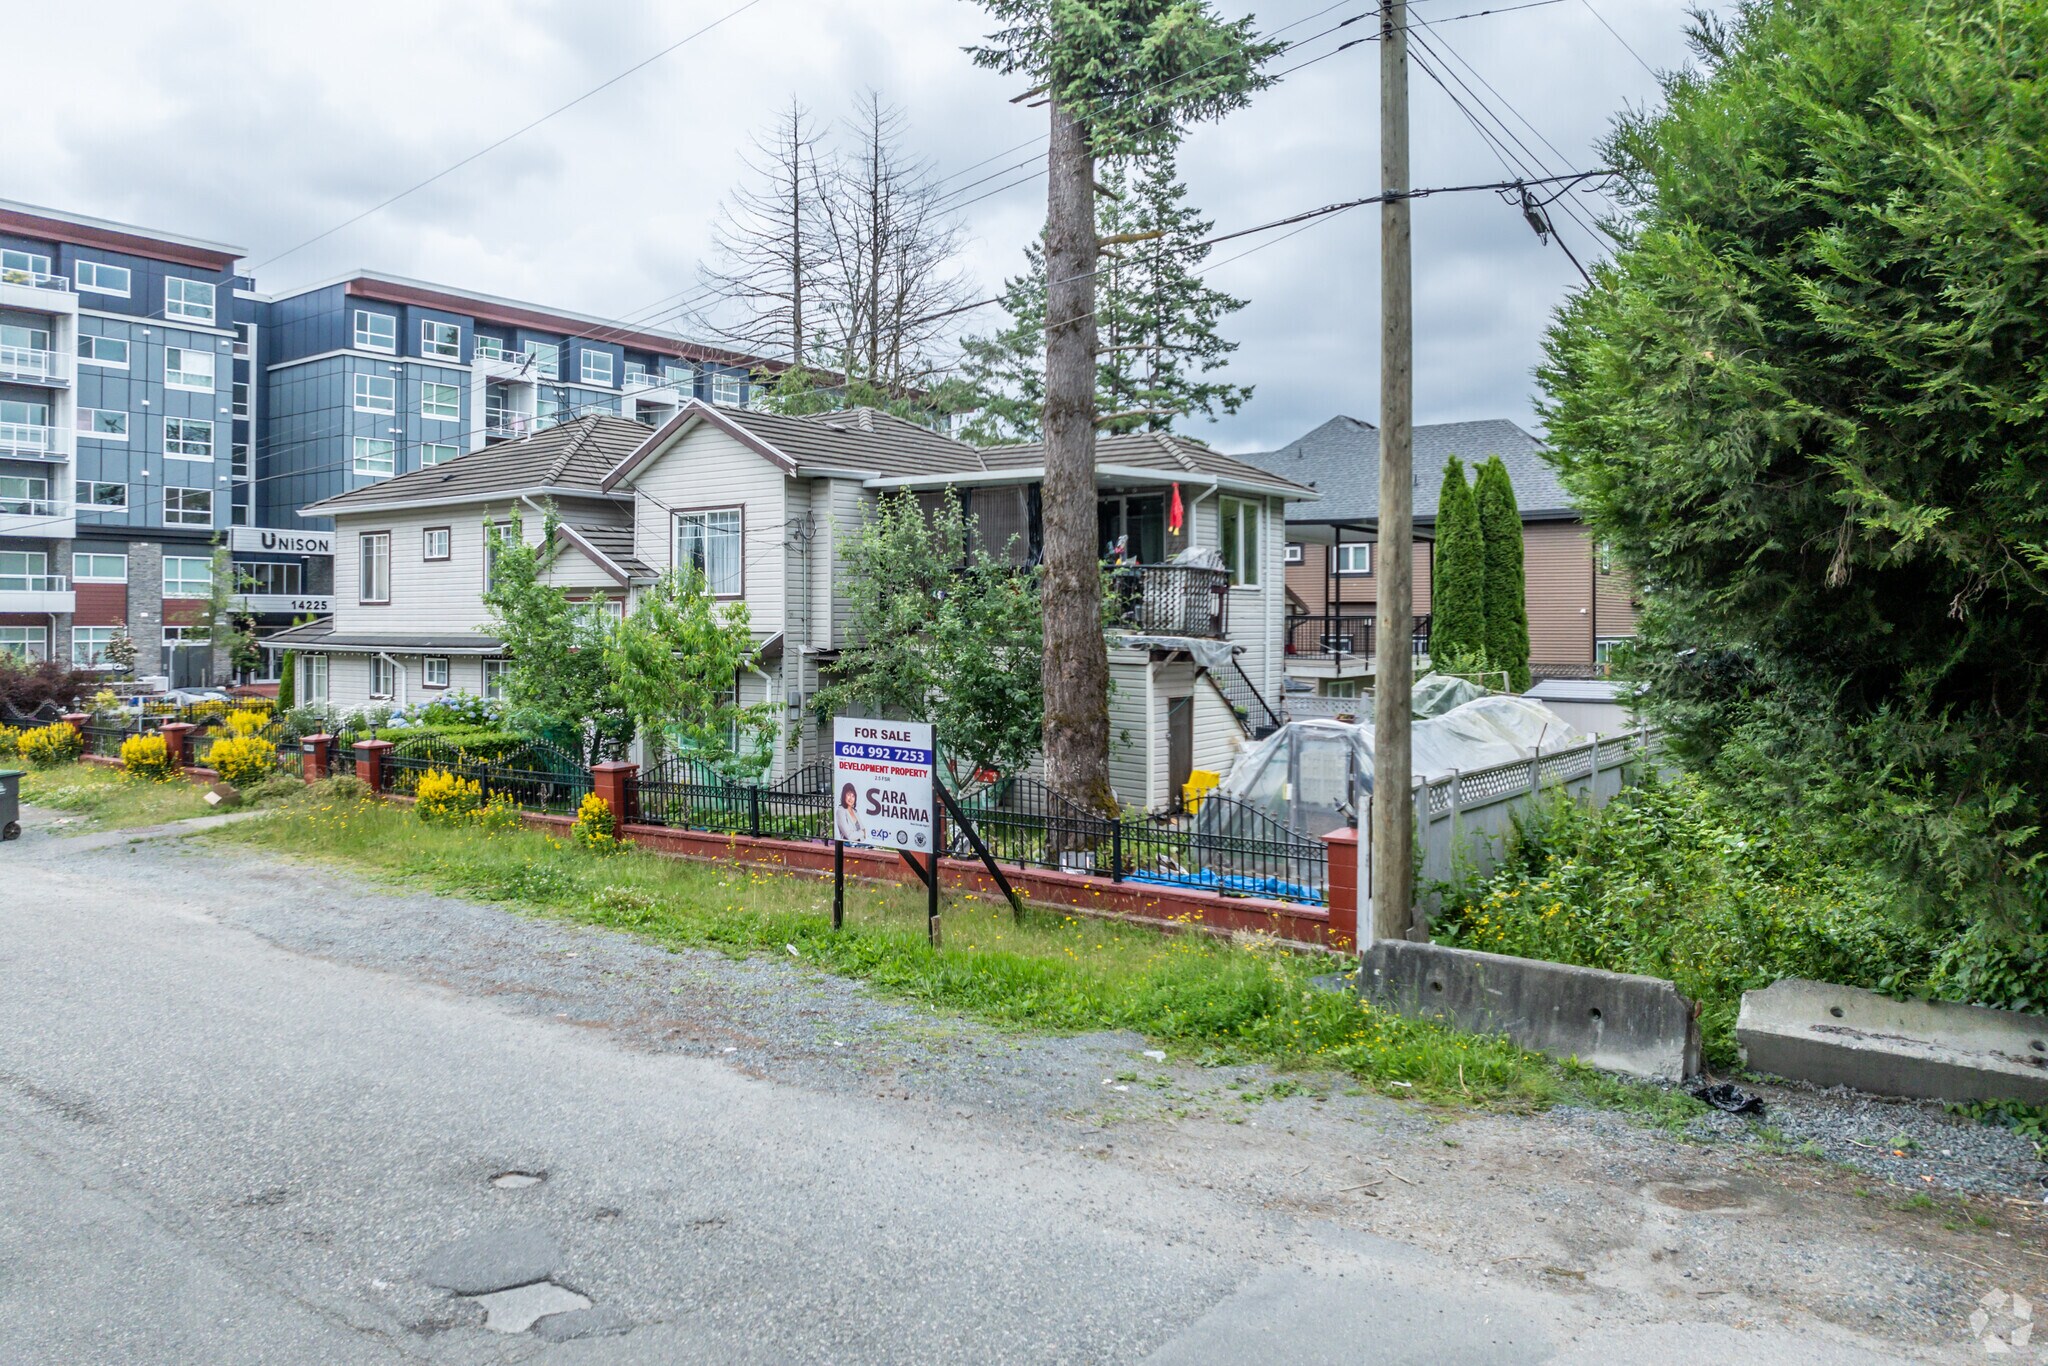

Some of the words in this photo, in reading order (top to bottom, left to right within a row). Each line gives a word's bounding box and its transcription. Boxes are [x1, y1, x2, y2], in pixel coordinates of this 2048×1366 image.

[291, 600, 328, 610] 14225
[854, 727, 877, 739] FOR
[881, 729, 911, 742] SALE
[841, 744, 865, 757] 604
[868, 747, 891, 759] 992
[894, 749, 925, 762] 7253
[839, 761, 889, 774] DEVELOPMENT
[890, 765, 928, 778] PROPERTY
